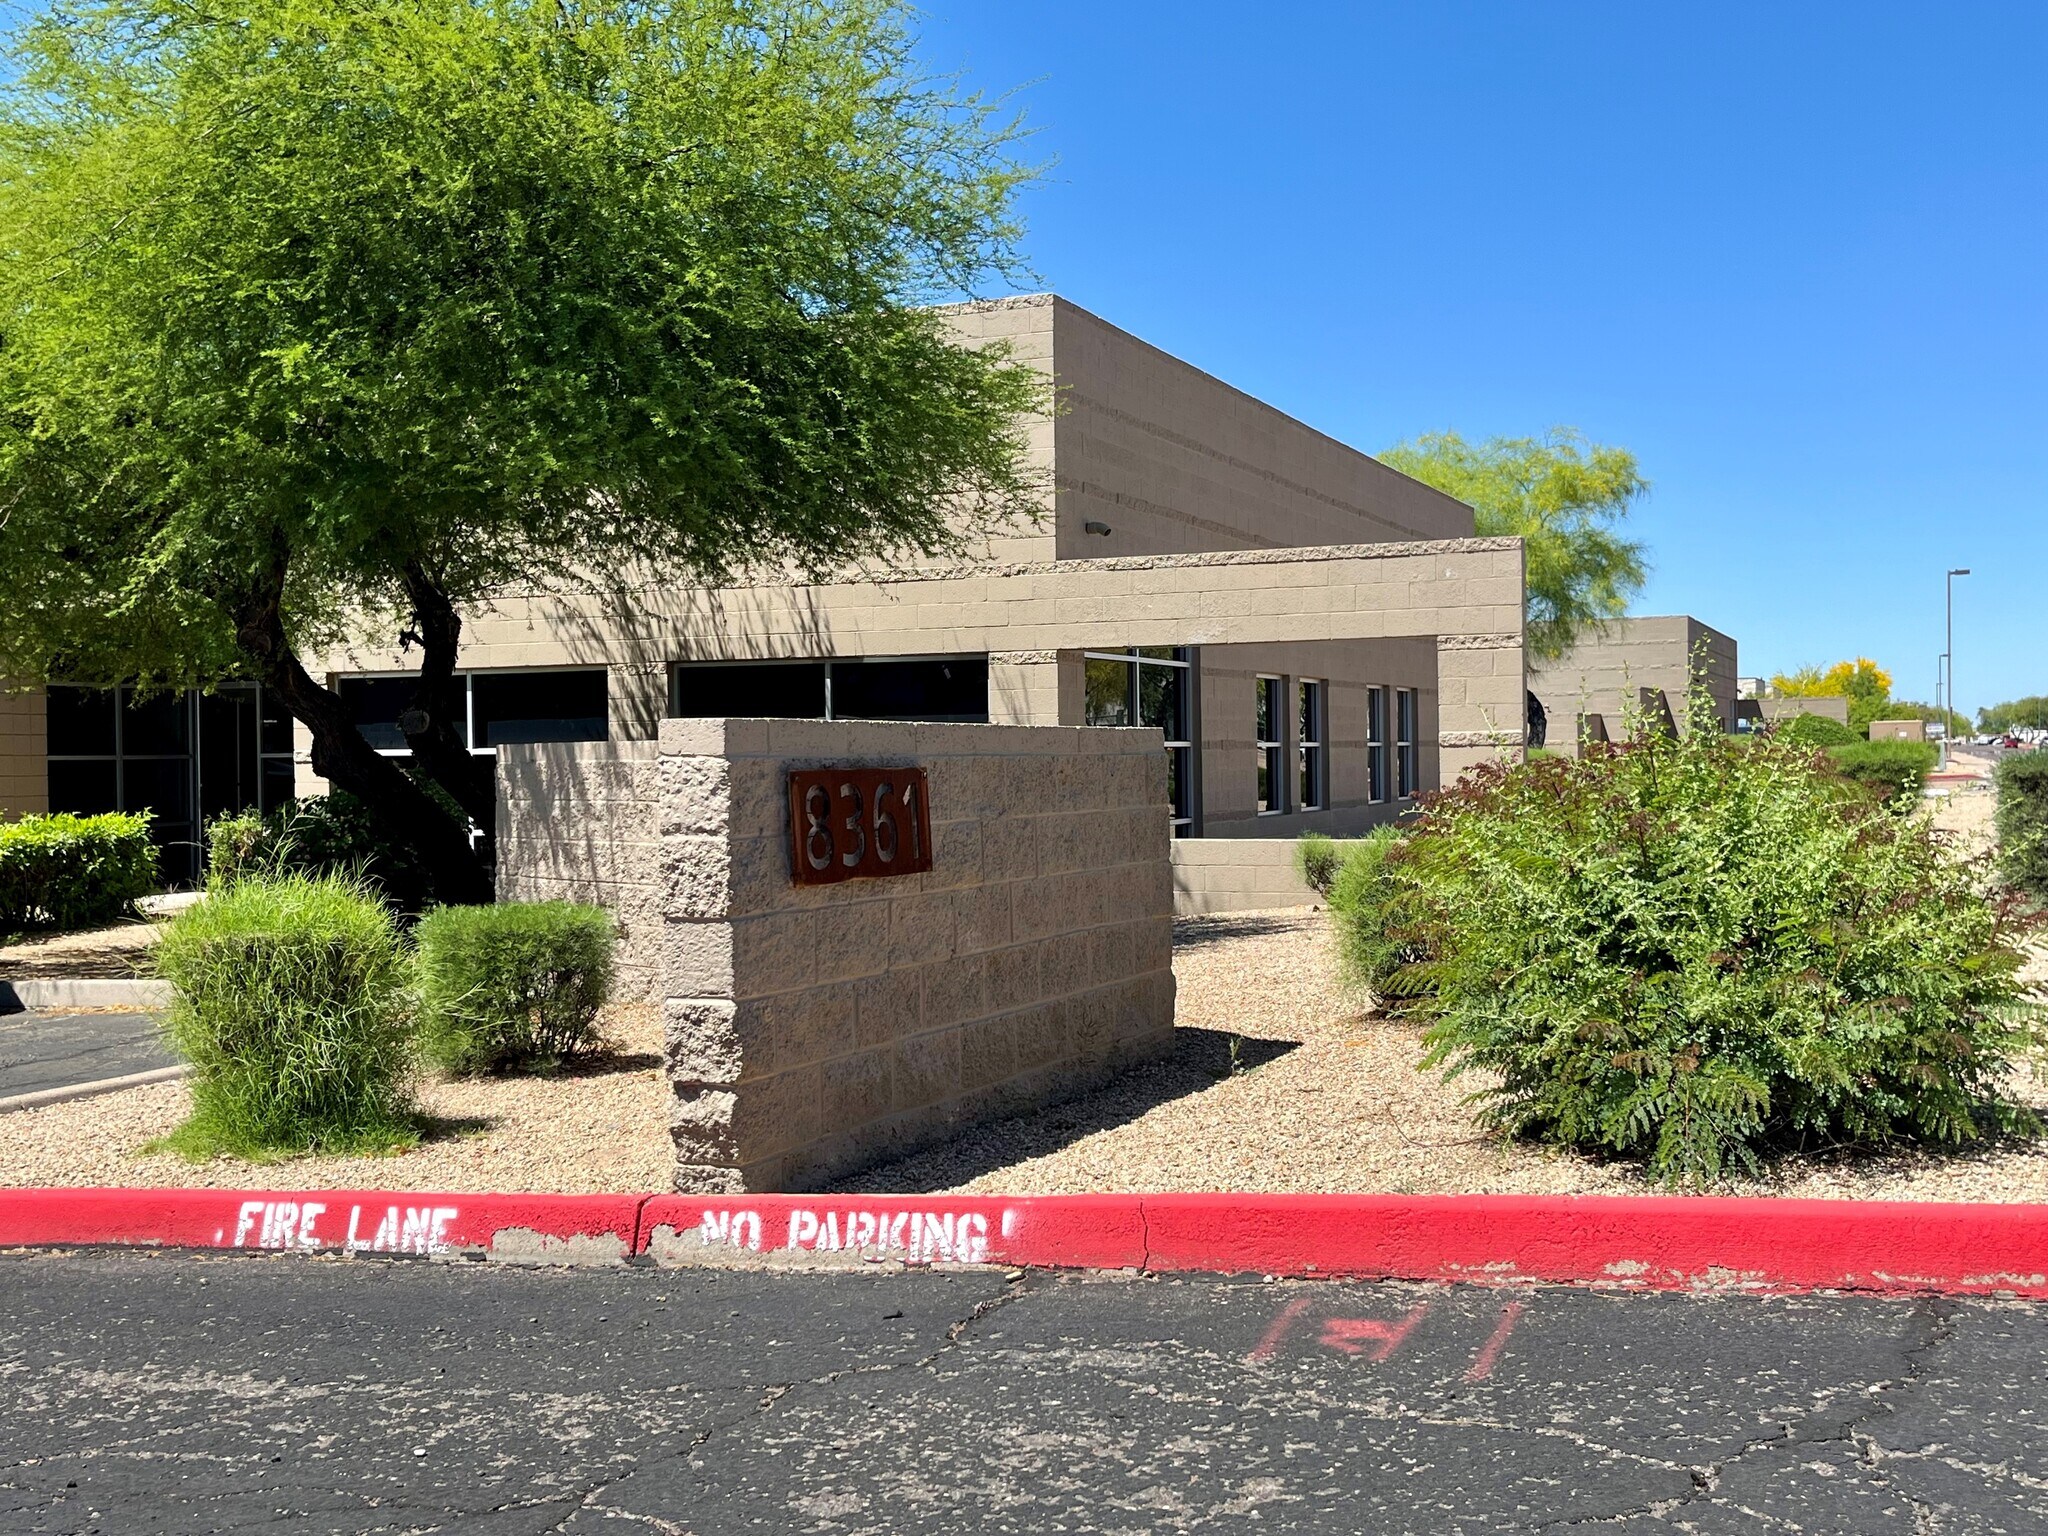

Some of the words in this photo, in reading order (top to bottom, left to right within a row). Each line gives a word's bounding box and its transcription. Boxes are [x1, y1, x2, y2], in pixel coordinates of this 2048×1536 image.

[806, 783, 920, 870] 8361
[234, 1202, 326, 1248] FIRE
[347, 1204, 458, 1254] LANE
[701, 1210, 762, 1250] NO
[788, 1210, 988, 1263] PARKING
